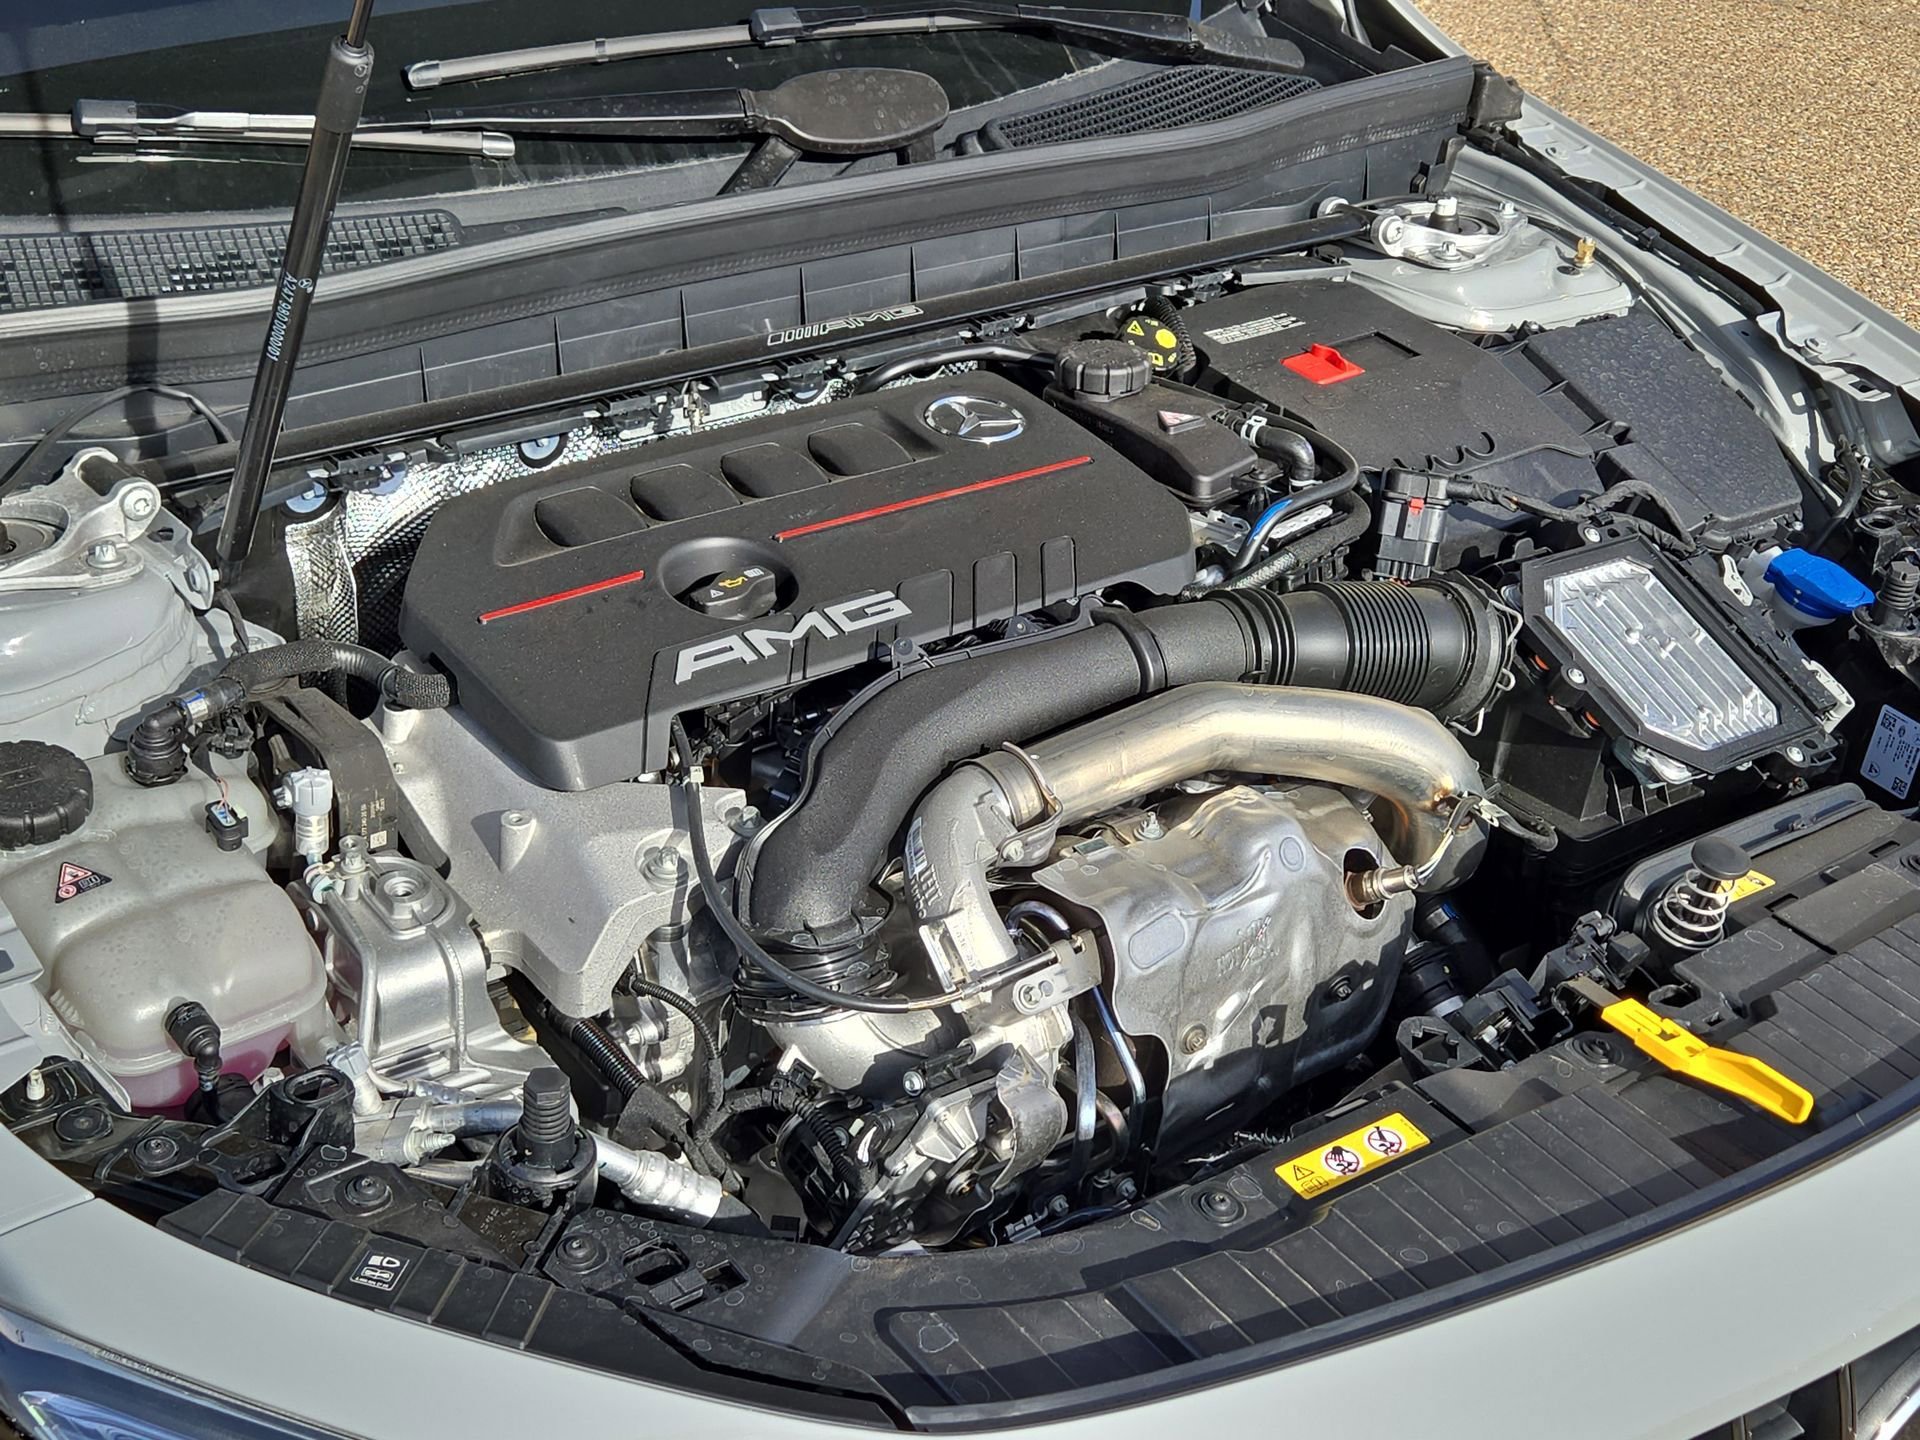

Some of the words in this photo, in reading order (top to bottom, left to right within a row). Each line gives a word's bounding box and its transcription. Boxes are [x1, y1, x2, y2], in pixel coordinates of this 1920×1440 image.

[281, 271, 298, 303] A247
[276, 300, 292, 321] 980
[266, 319, 287, 361] 0000/01
[674, 590, 913, 686] AMG
